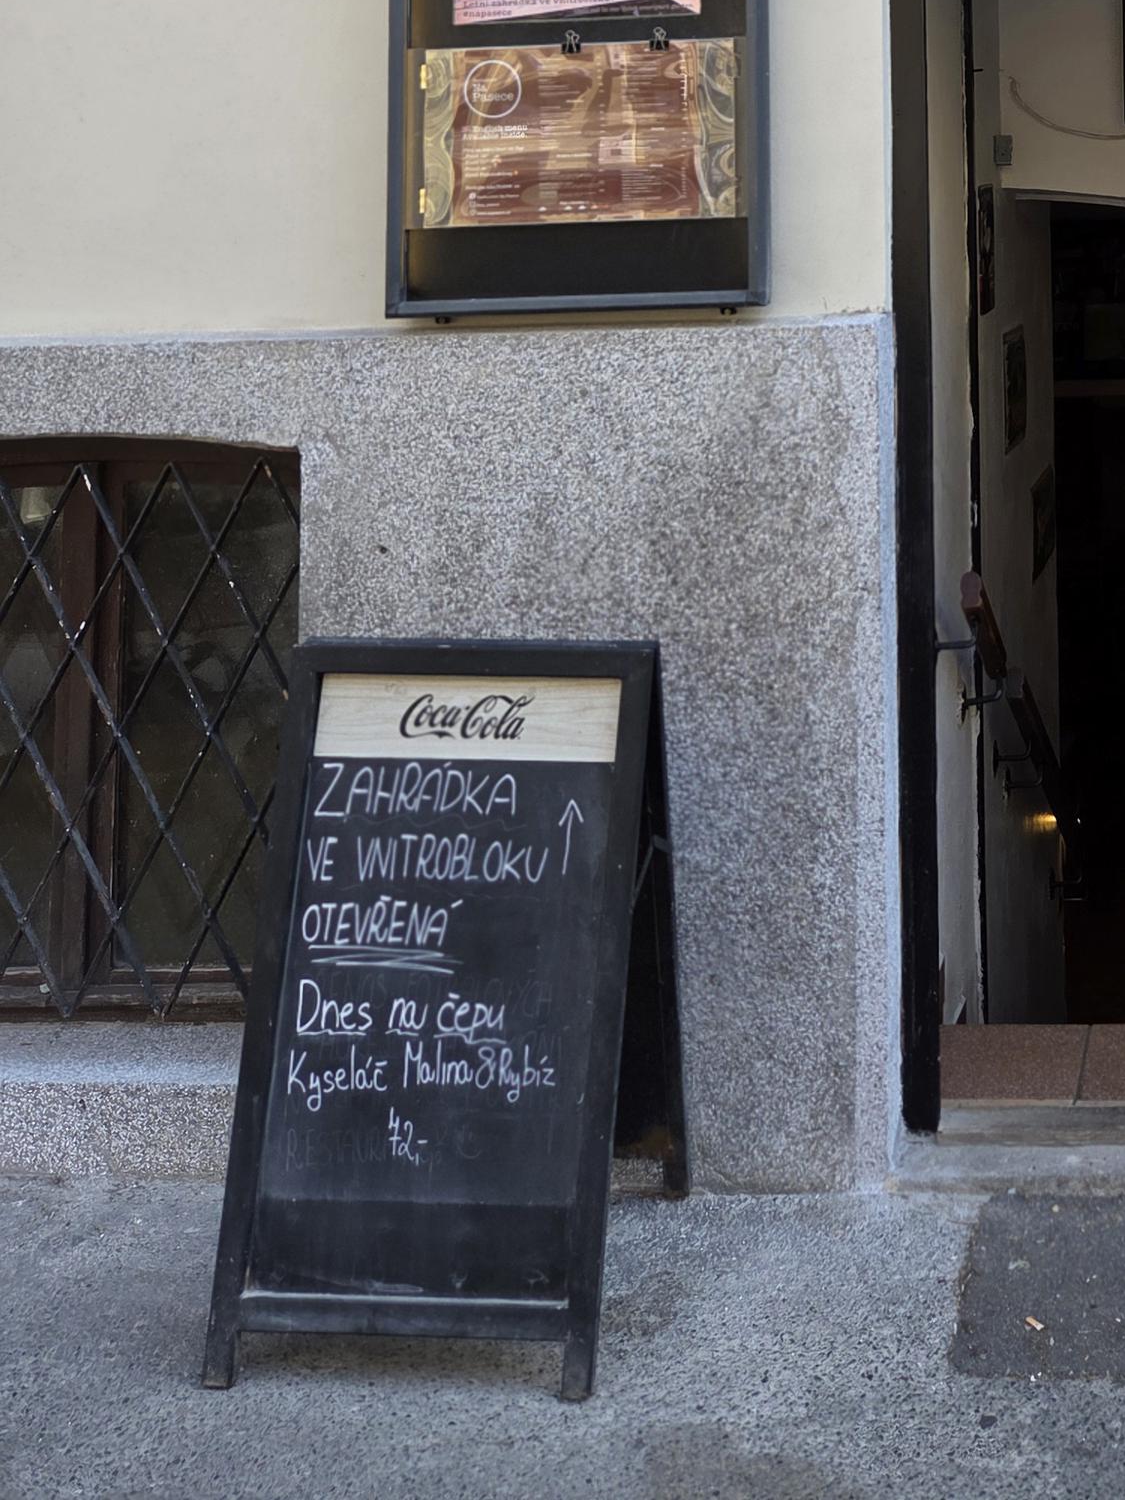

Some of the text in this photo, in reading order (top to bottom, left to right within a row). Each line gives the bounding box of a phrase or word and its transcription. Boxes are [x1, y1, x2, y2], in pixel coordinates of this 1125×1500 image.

[314, 761, 516, 816] ZAHRÁDKA
[307, 833, 548, 883] VE VNITROBLOKU
[302, 895, 463, 947] OTEVŘENÁ
[296, 979, 373, 1033] Dnes
[388, 997, 427, 1031] na
[436, 993, 504, 1044] čepu
[287, 1044, 388, 1112] Kyseláč
[402, 1039, 473, 1088] Malina
